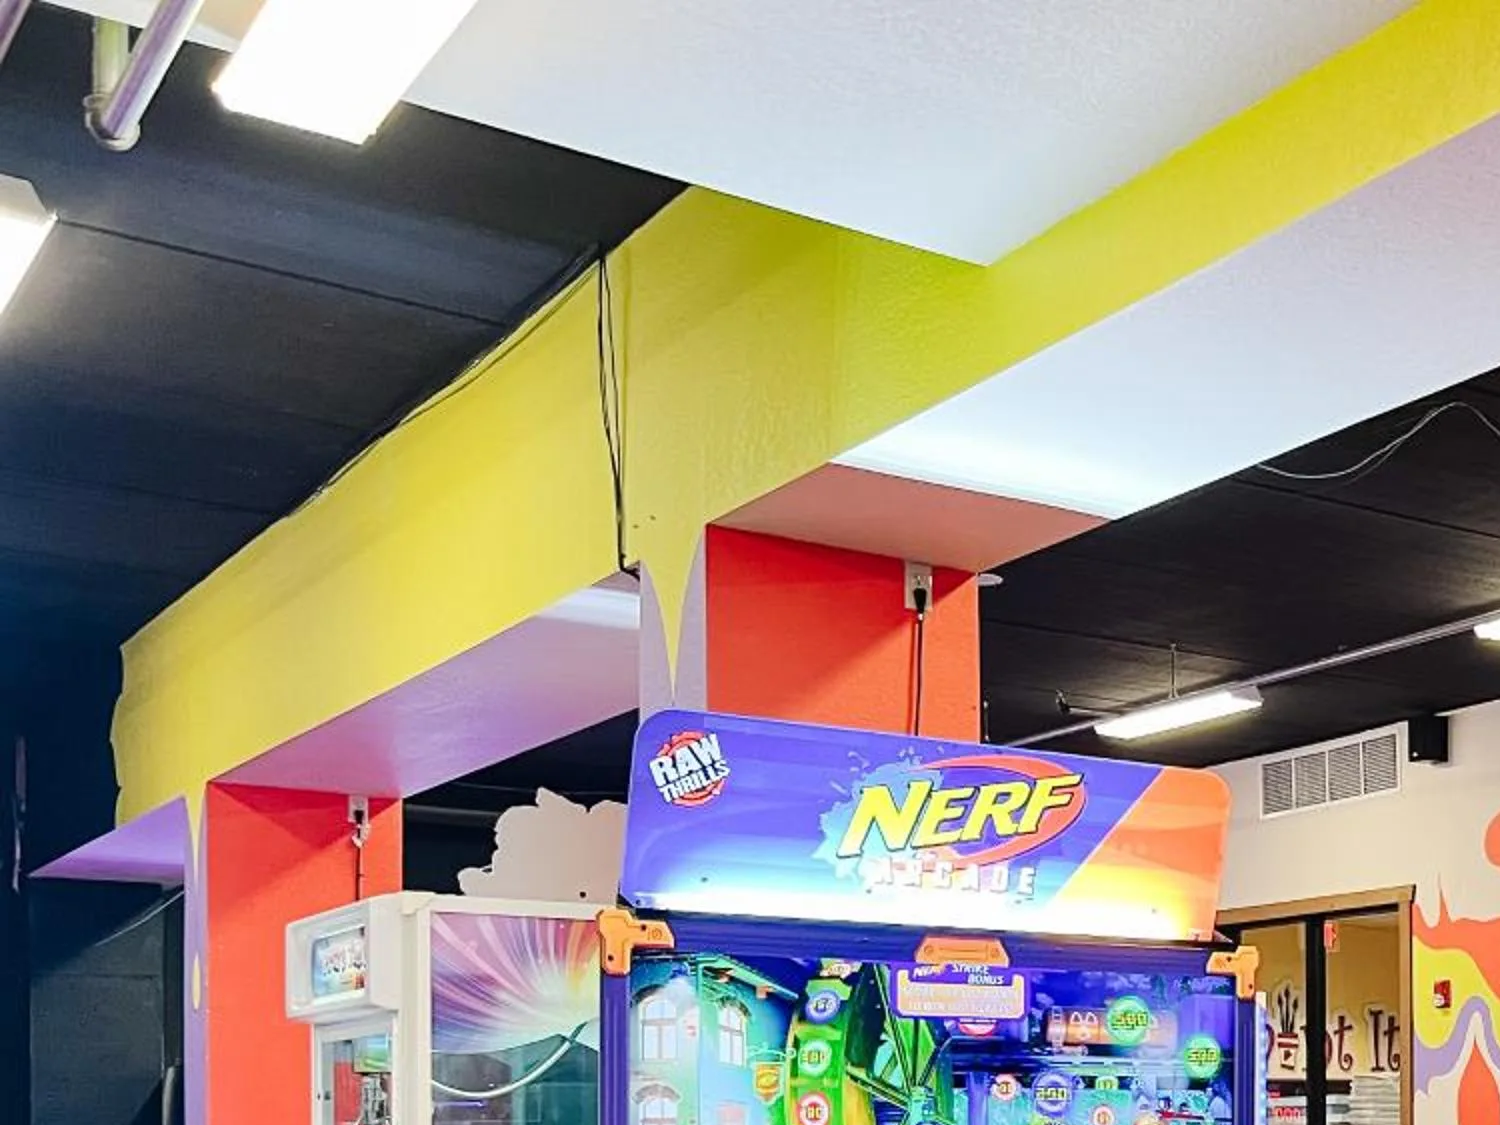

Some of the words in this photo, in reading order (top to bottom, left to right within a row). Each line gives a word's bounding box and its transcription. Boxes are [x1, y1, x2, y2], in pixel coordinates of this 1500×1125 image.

[650, 734, 721, 787] RAW
[659, 760, 731, 803] THRILLS
[836, 773, 1085, 859] NERF
